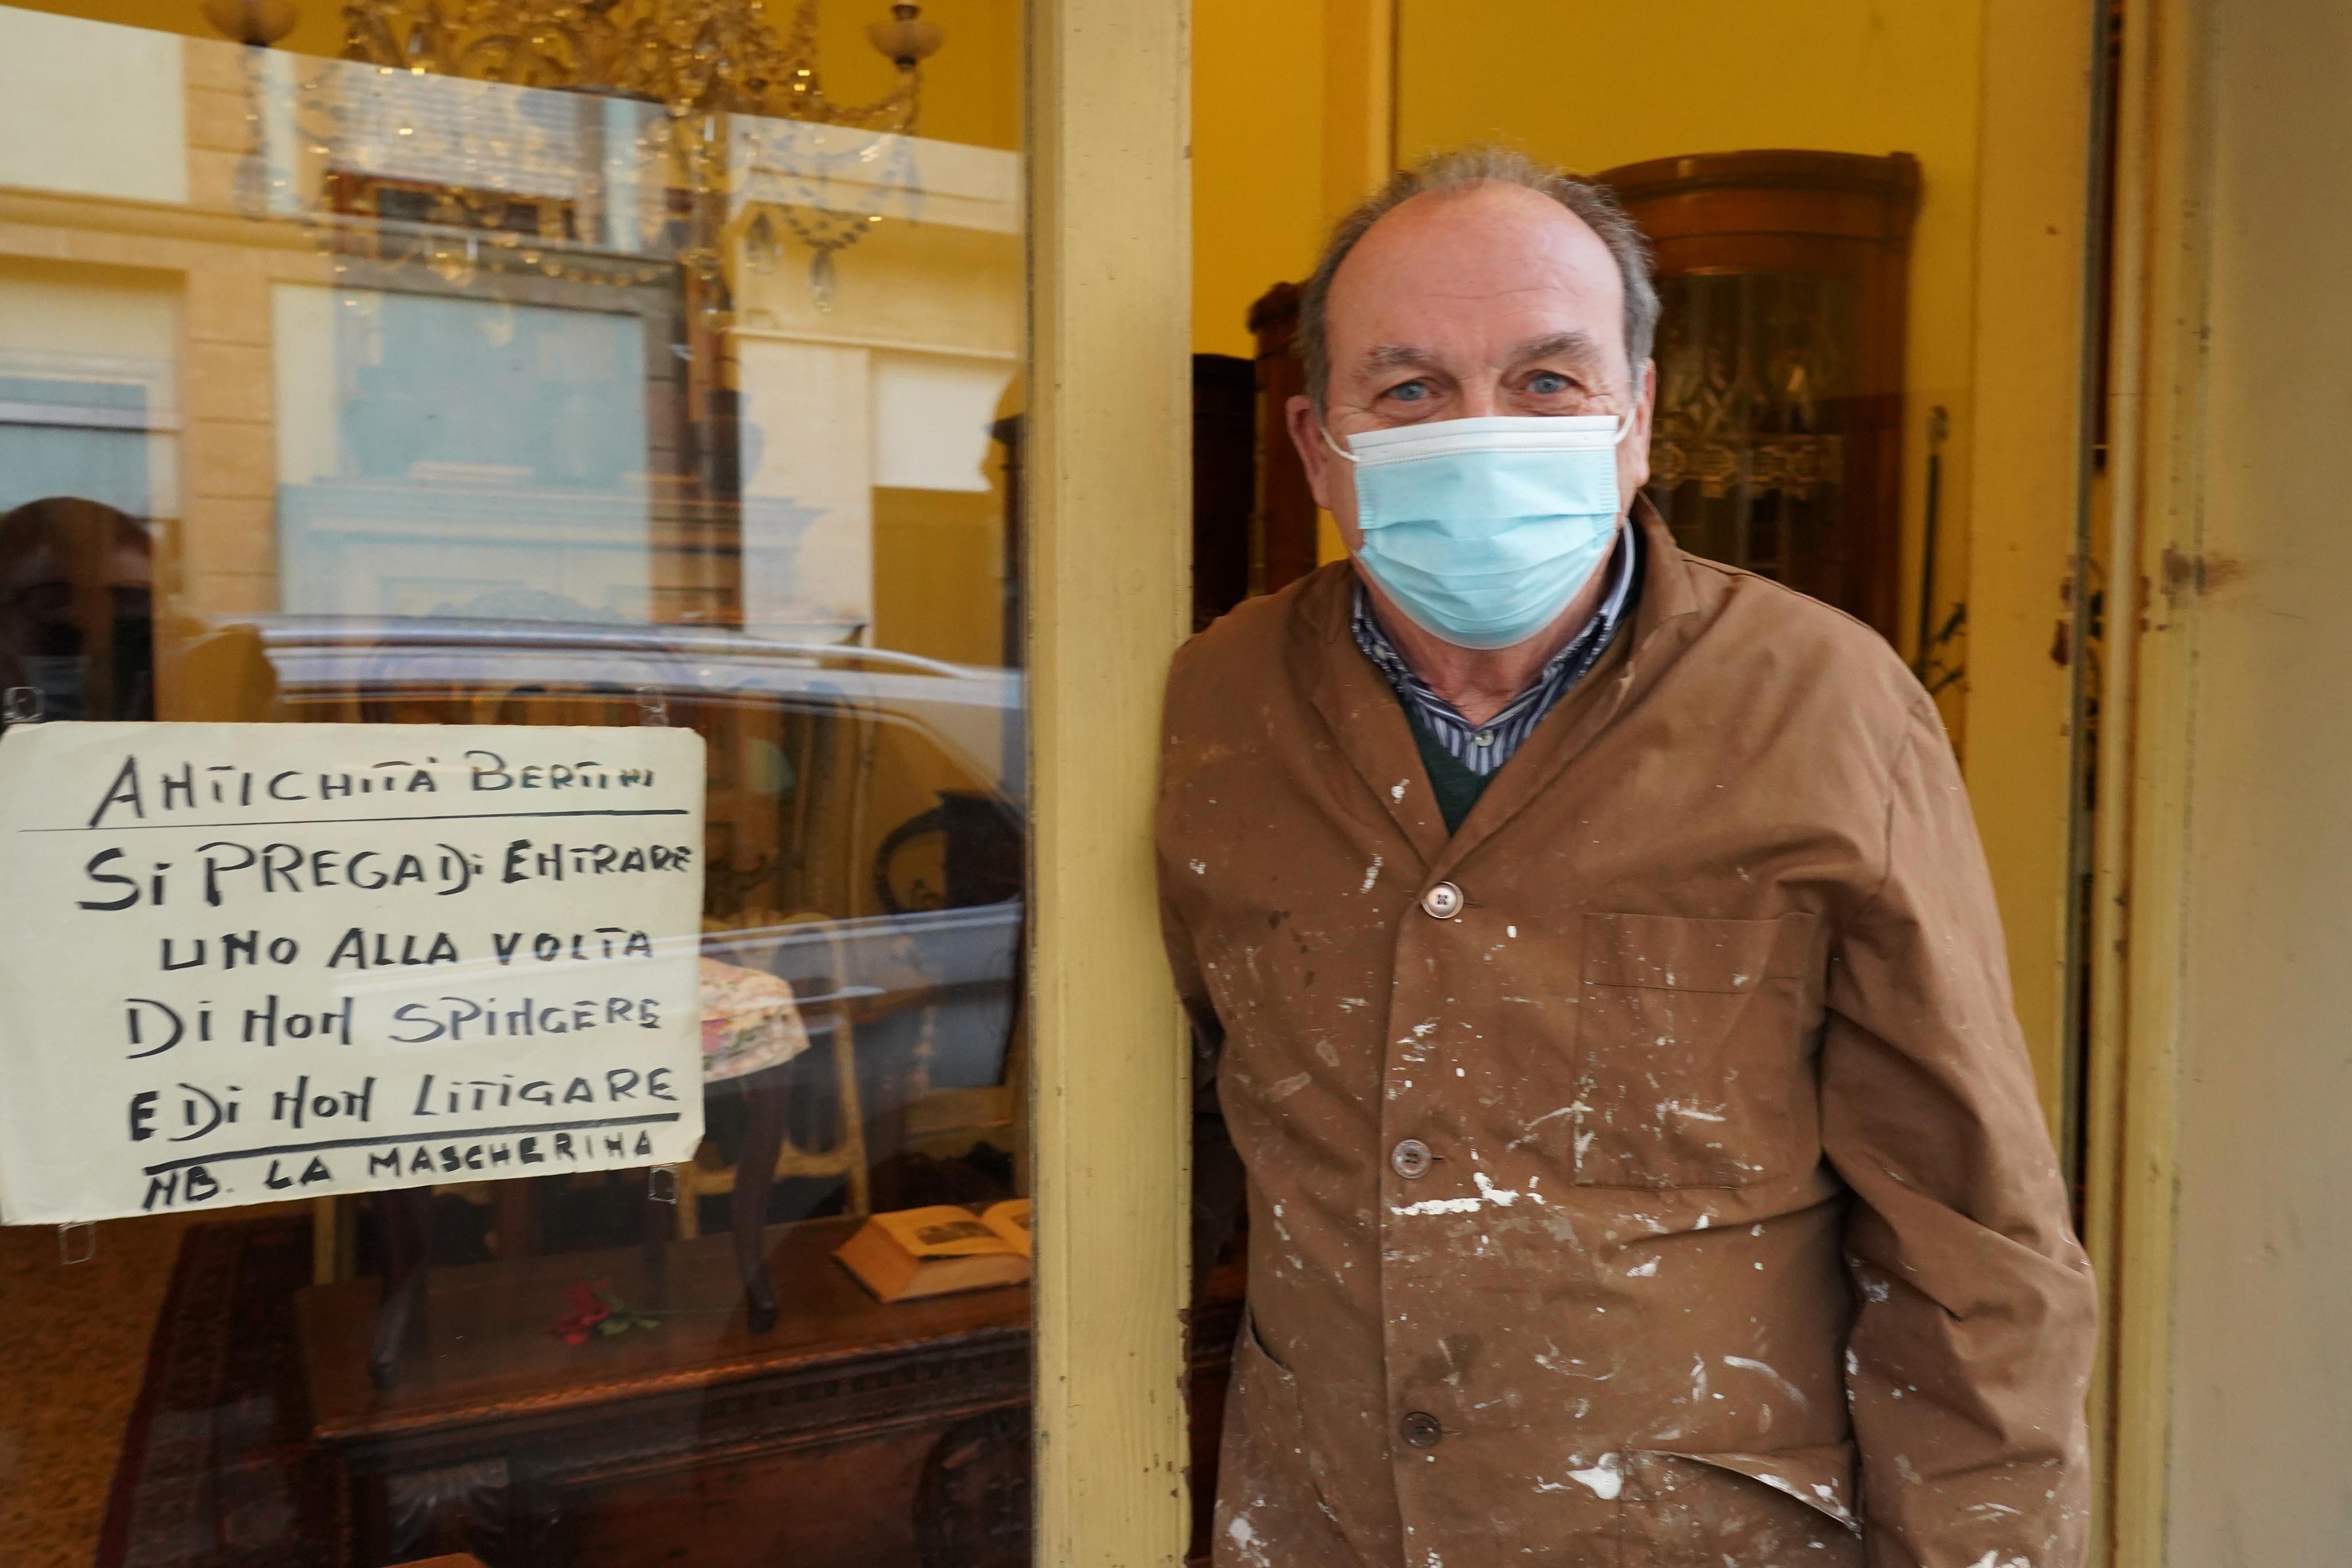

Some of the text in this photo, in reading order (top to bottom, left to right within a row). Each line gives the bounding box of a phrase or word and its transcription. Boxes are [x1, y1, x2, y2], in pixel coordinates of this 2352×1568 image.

[464, 750, 655, 791] BERTINI
[195, 842, 427, 907] PREGA
[502, 839, 694, 884] ENTRARE
[160, 927, 653, 971] UNO ALLA VOLTA
[242, 994, 354, 1046] NON
[129, 1090, 161, 1141] E
[272, 1075, 378, 1128] NON
[264, 1155, 334, 1189] LA
[367, 1130, 655, 1177] MASCHERINA
